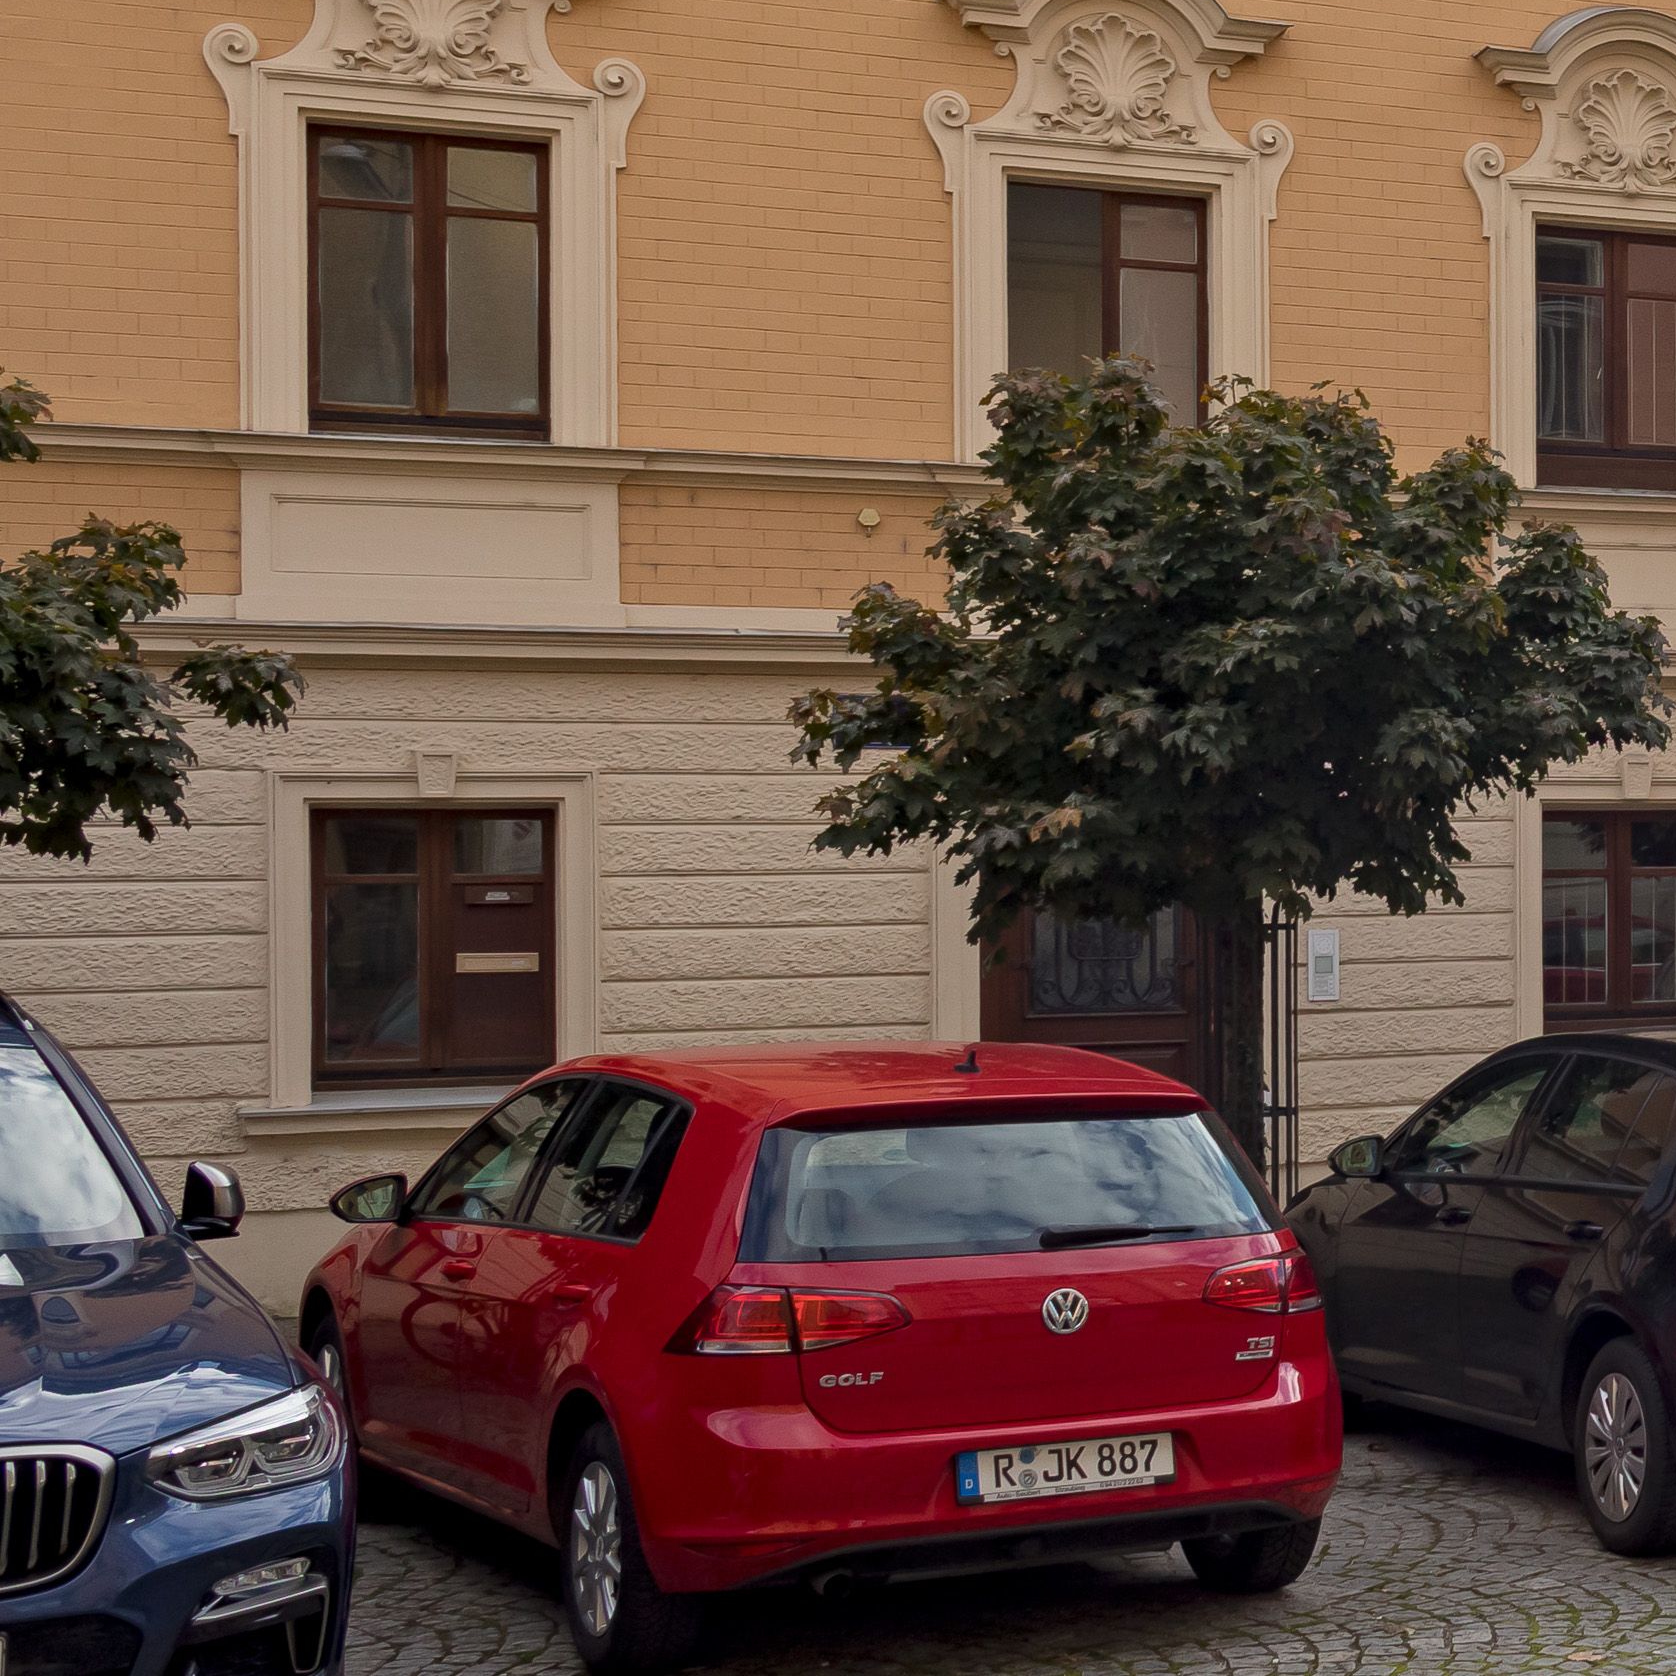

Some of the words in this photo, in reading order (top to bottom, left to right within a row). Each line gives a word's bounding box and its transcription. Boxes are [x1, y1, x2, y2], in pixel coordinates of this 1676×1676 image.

[819, 1371, 884, 1387] GOLF
[993, 1453, 1017, 1489] R
[1043, 1445, 1088, 1483] JK
[1097, 1438, 1159, 1477] 887
